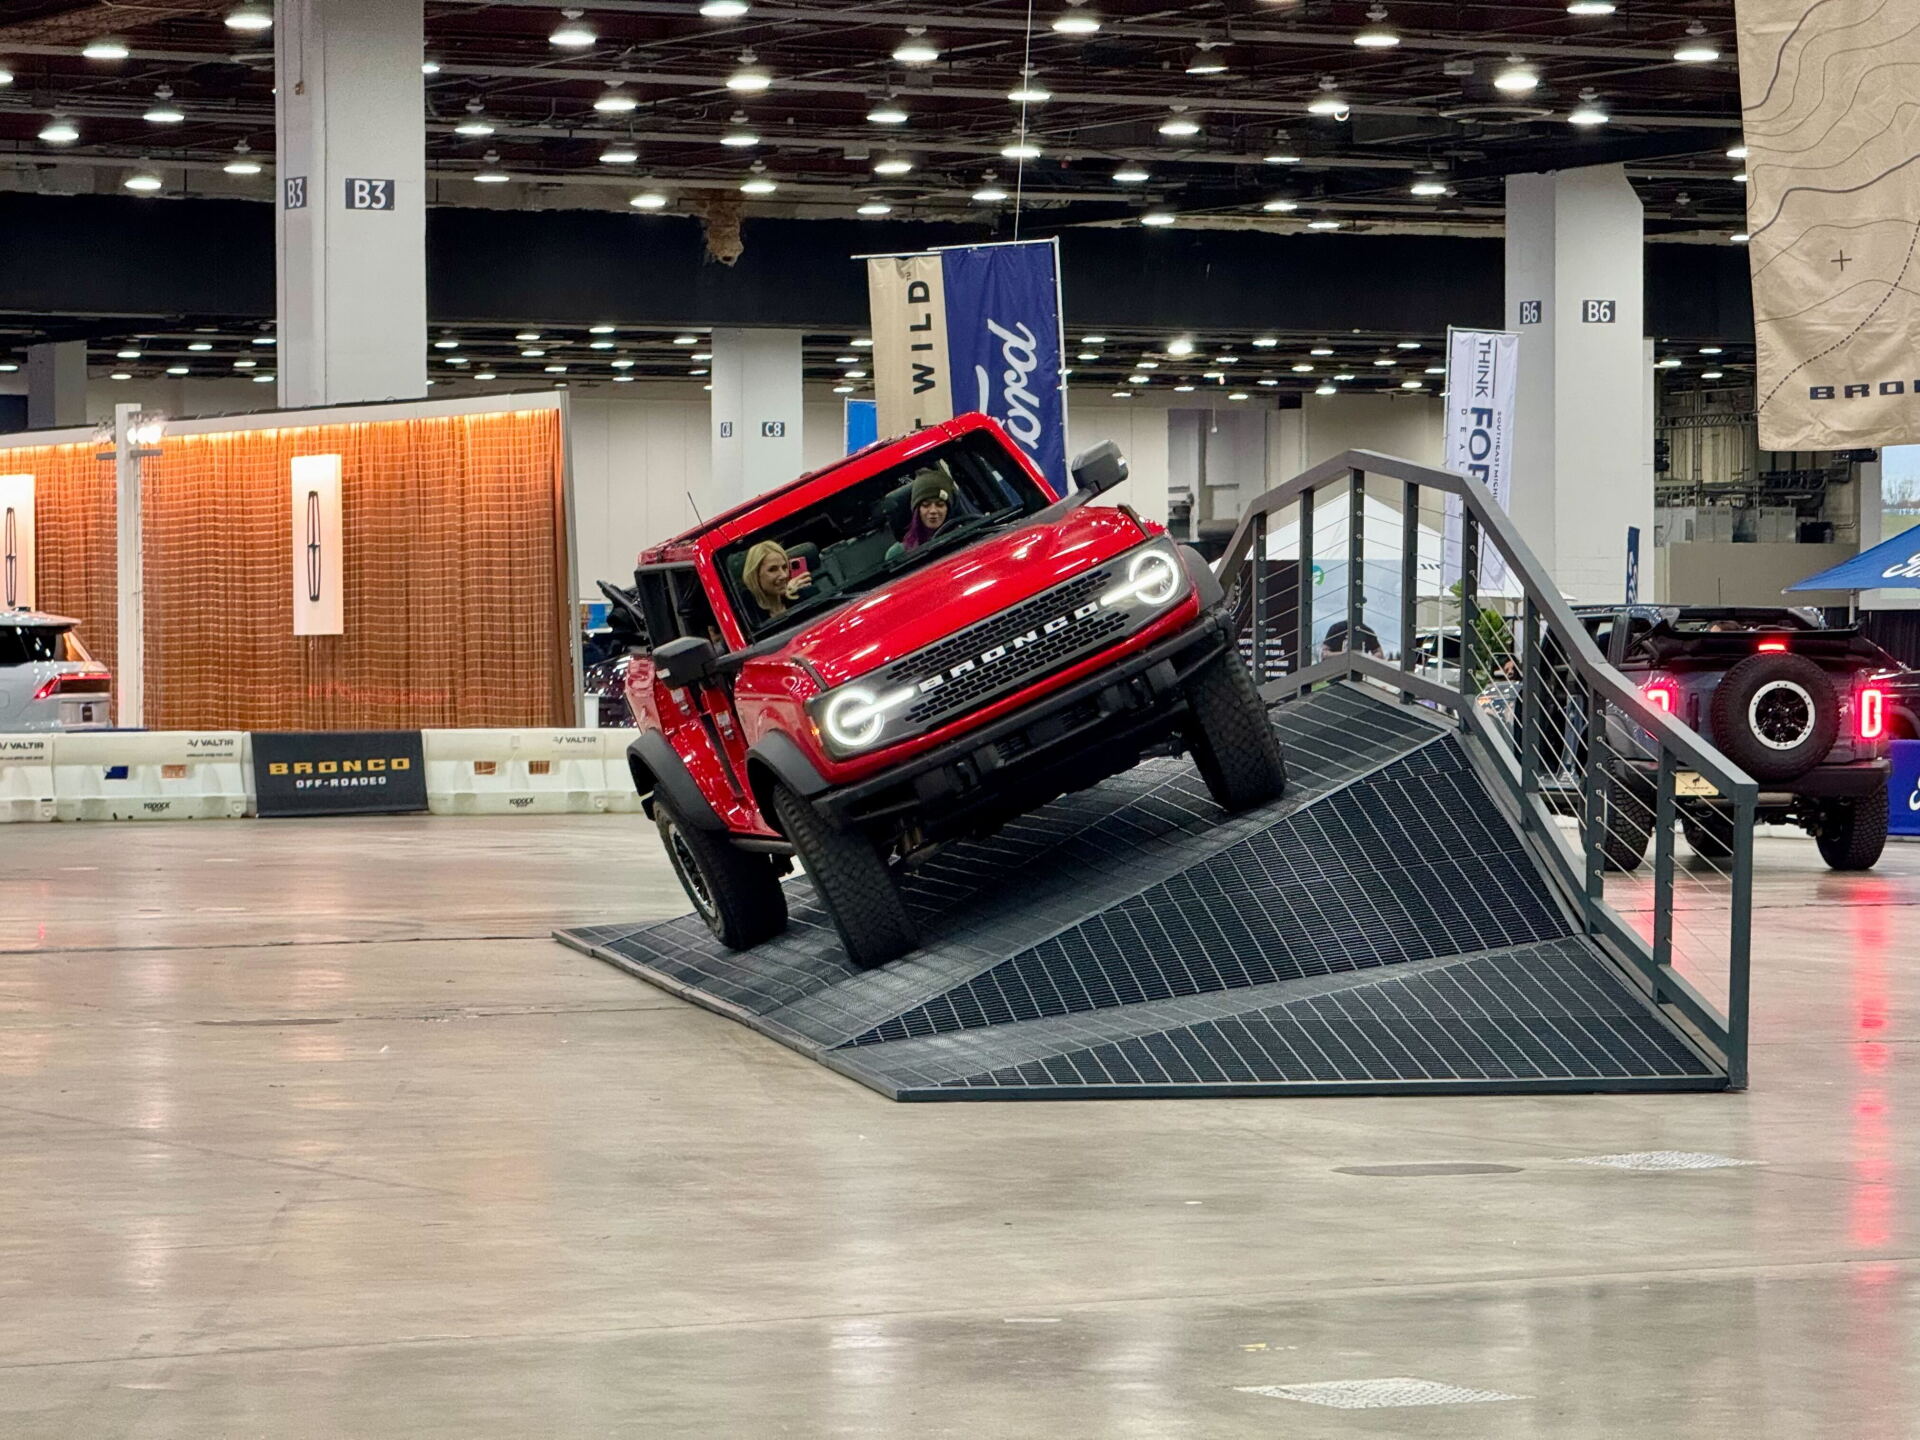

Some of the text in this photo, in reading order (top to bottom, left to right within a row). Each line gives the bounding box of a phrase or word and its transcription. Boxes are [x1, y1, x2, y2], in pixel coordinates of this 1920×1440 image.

[287, 178, 303, 209] B3
[354, 180, 387, 209] B3
[1522, 301, 1539, 324] B6
[1587, 300, 1611, 322] B6
[1474, 339, 1492, 398] THINK
[1809, 380, 1920, 400] BRO
[765, 422, 782, 437] C8
[1468, 407, 1494, 484] FOR
[1492, 411, 1502, 500] SOUTHEAST MICHI
[917, 601, 1099, 694] BRONCO
[10, 741, 44, 750] VALTIR
[200, 738, 234, 746] VALTIR
[269, 757, 410, 776] BRONCO
[296, 771, 387, 788] OFF-ROADEO
